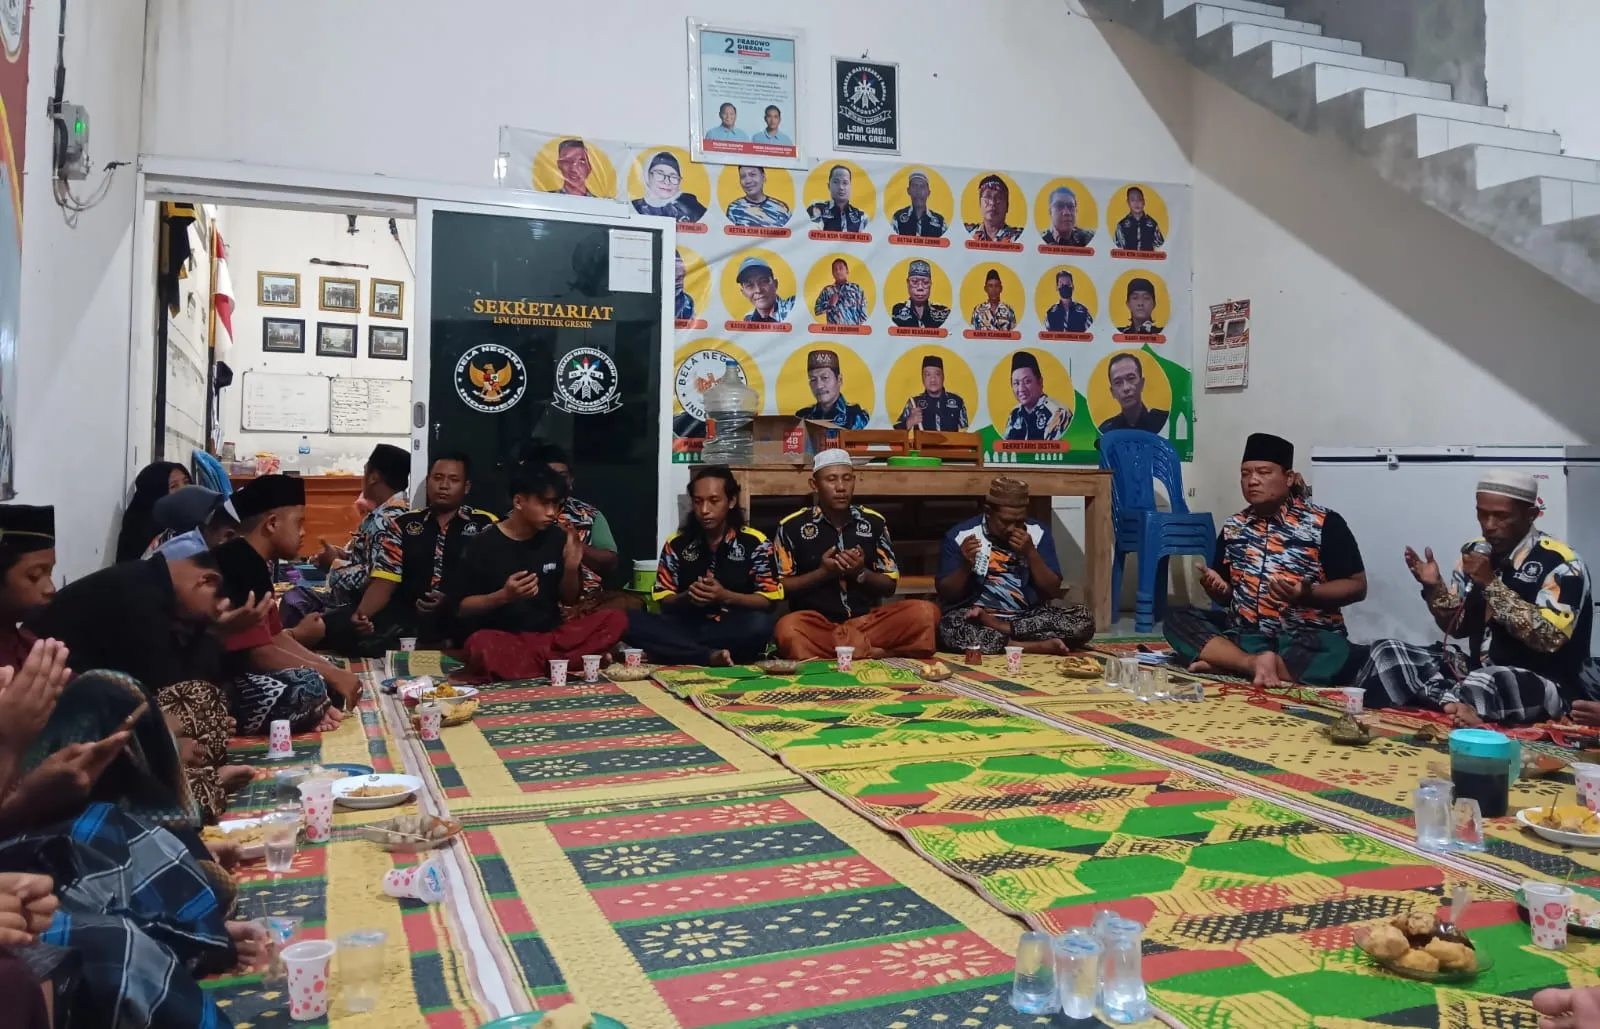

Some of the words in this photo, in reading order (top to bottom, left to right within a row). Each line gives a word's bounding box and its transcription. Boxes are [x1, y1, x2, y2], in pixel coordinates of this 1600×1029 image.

[724, 37, 735, 54] 2
[737, 38, 770, 47] PRABOWO
[737, 44, 763, 52] GIBRAN
[847, 125, 864, 133] LSM
[866, 126, 887, 135] GMBI
[839, 132, 868, 143] DISTRIK
[868, 135, 895, 145] GRESIK
[473, 299, 614, 321] SEKRETARIAT
[493, 316, 509, 324] LSM
[510, 317, 533, 325] GMBI
[533, 319, 565, 328] DISTRIK
[565, 320, 593, 329] GRESIK
[458, 350, 479, 373] BELA
[481, 346, 522, 371] NEGARA
[678, 357, 699, 386] BELA
[460, 386, 524, 411] INDONESIA
[786, 436, 799, 445] 48
